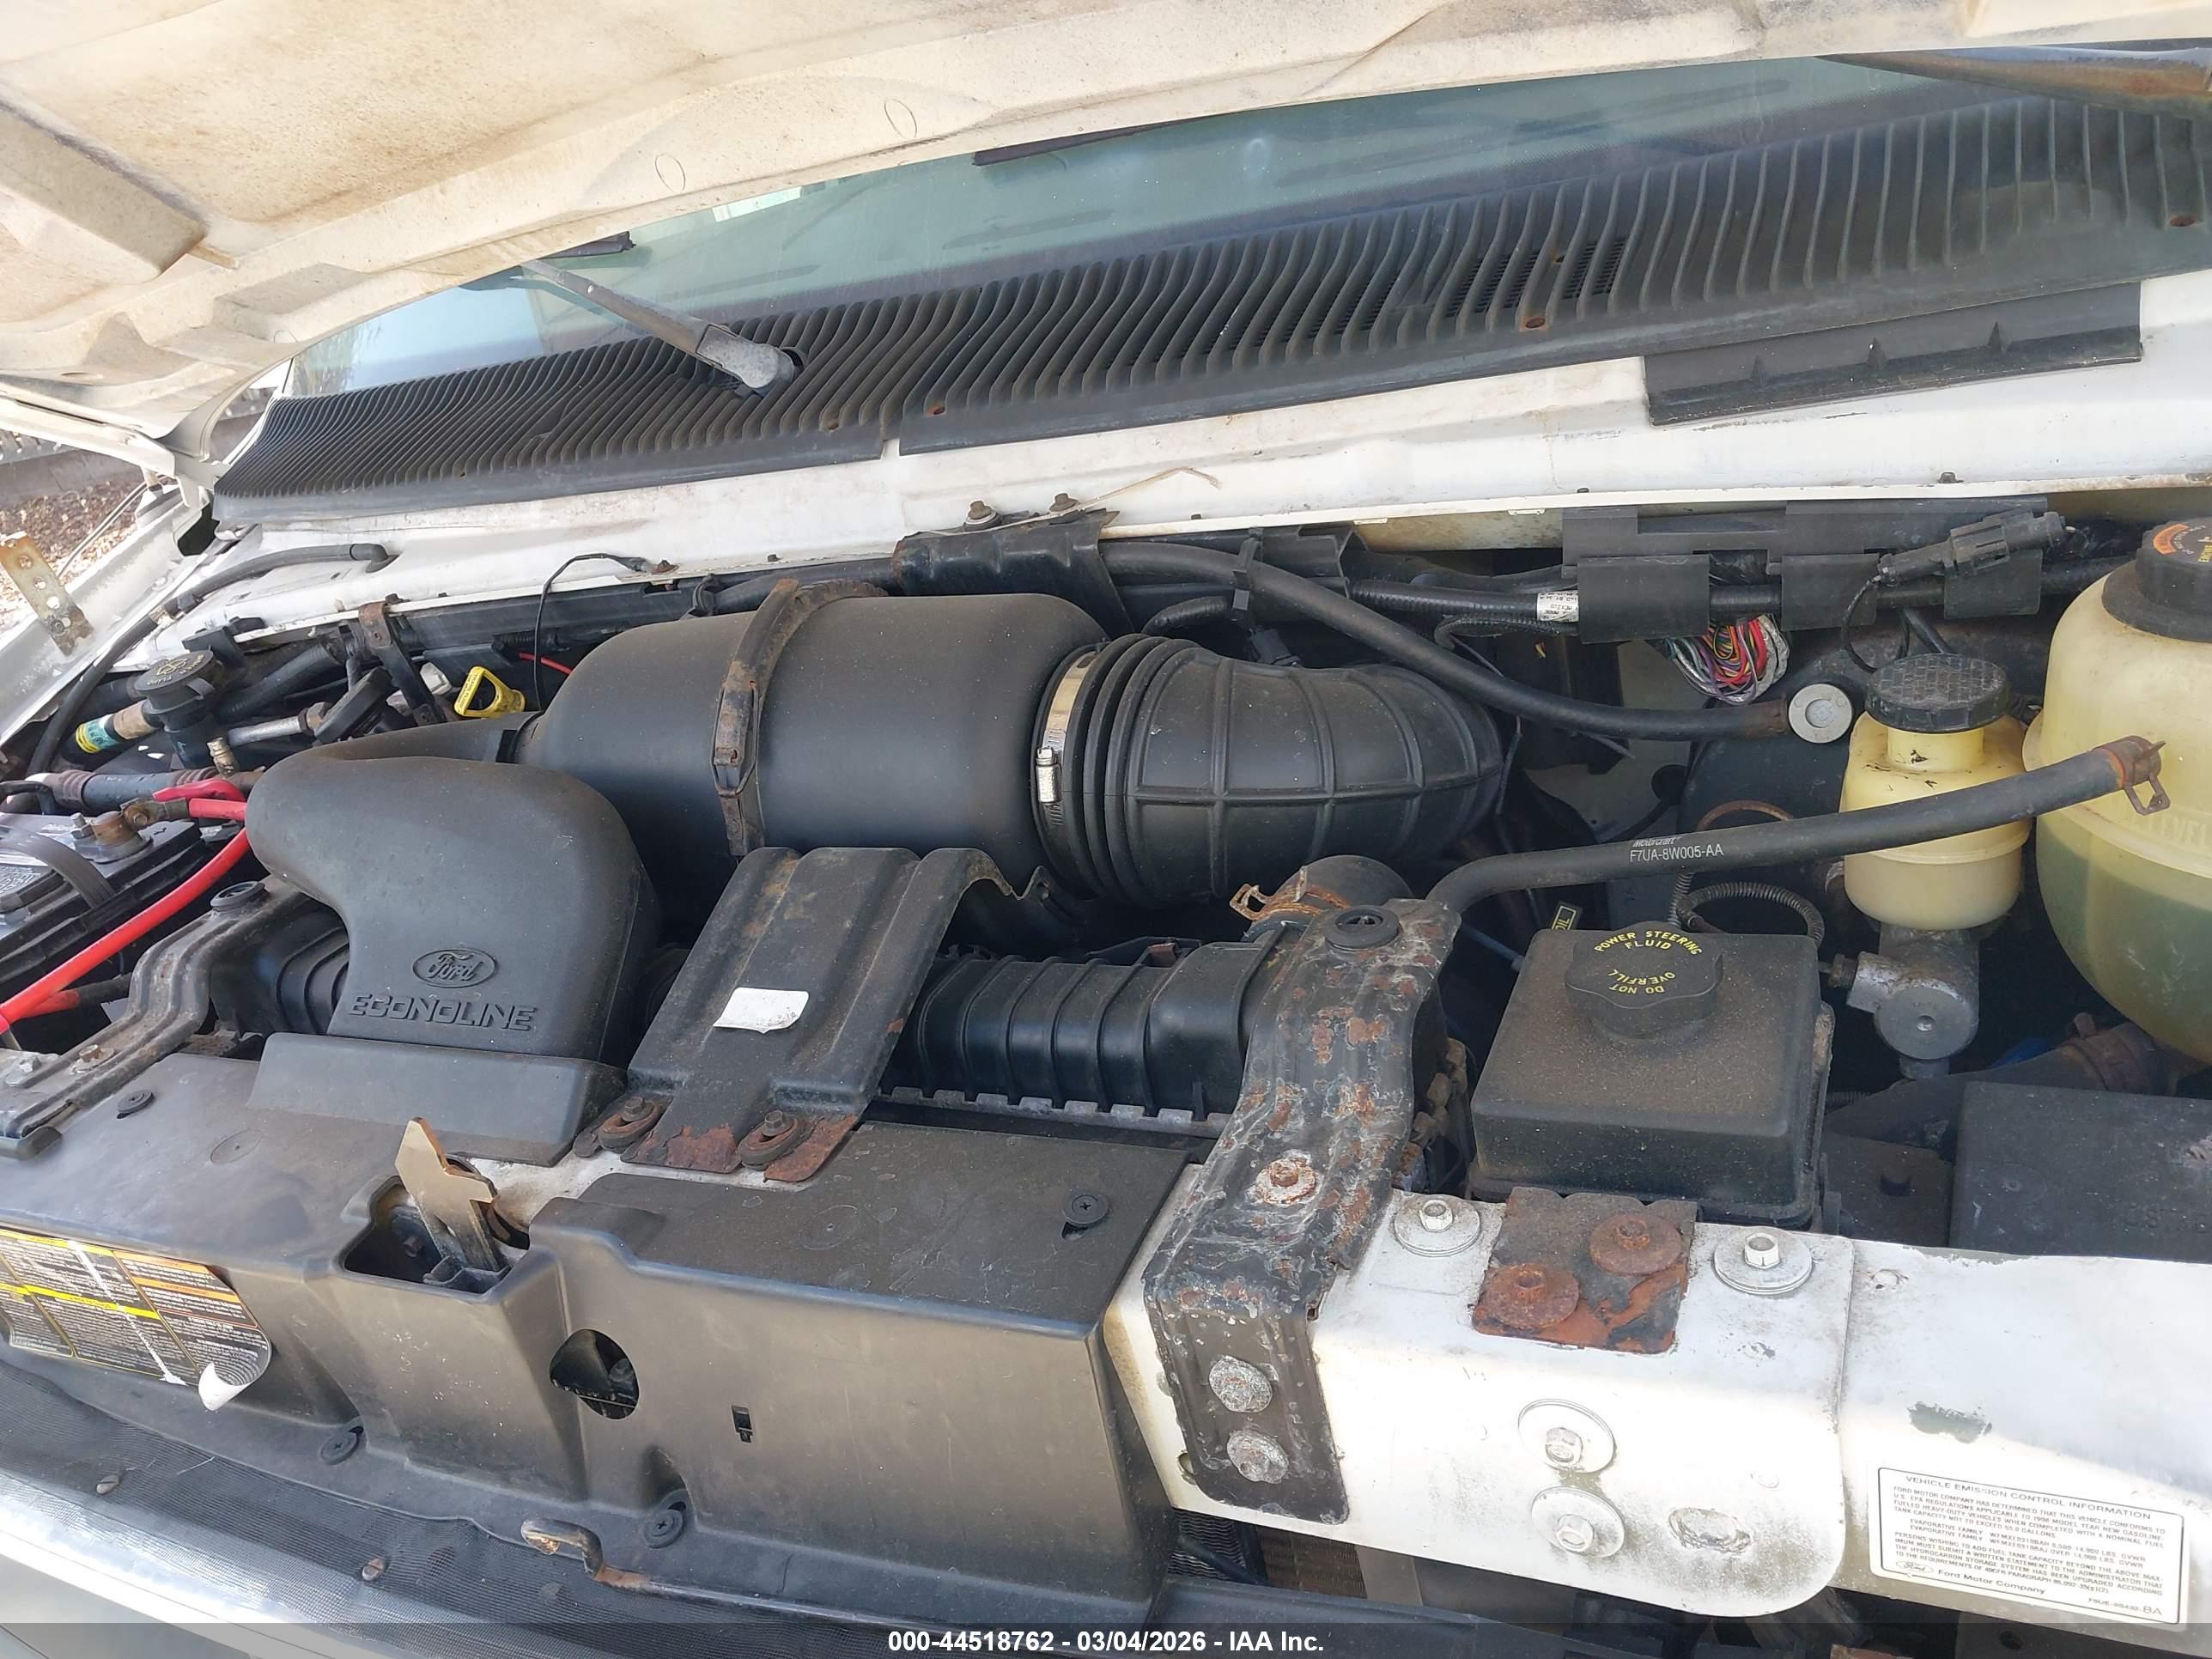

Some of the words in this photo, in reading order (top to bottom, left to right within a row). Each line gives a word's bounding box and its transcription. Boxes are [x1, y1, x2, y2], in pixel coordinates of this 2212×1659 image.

[1630, 843, 1724, 863] F7UA-8W005-AA
[1594, 933, 1637, 953] POWER
[1645, 931, 1703, 955] STEERING
[1624, 939, 1672, 951] FLUID
[428, 951, 483, 982] Ford
[1608, 969, 1676, 986] OVERFILL
[1608, 984, 1638, 994] NOT
[1645, 985, 1666, 994] DO
[349, 993, 538, 1032] ECONOLINE
[1905, 1476, 1950, 1488] VEHICLE
[1954, 1483, 2006, 1497] EMISSION
[2010, 1492, 2063, 1506] CONTROL
[2069, 1501, 2150, 1519] INFORMATION
[1914, 1489, 1938, 1498] MOTOR
[1941, 1493, 1973, 1504] COMPANY
[1991, 1501, 2037, 1513] DETERMINED
[2078, 1515, 2106, 1524] VEHICLE
[2109, 1520, 2152, 1532] CONFORMS
[1893, 1499, 1919, 1509] FUELED
[1968, 1511, 2001, 1522] VEHICLES
[2028, 1522, 2073, 1533] COMPLETED
[2106, 1534, 2140, 1544] NOMINAL
[1913, 1510, 1945, 1519] CAPACITY
[1976, 1520, 2002, 1528] EXCEED
[1926, 1498, 1972, 1510] REGULATIONS
[1976, 1506, 2017, 1517] APPLICABLE
[2052, 1518, 2077, 1527] MODEL
[1894, 1531, 1926, 1541] PERSONS
[1929, 1537, 1959, 1547] WISHING
[2008, 1550, 2026, 1559] TANK
[2028, 1553, 2063, 1565] CAPACITY
[2066, 1560, 2095, 1570] BEYOND
[2115, 1568, 2139, 1577] ABOVE
[1917, 1541, 1935, 1550] MUST
[1938, 1546, 1964, 1554] SUBMIT
[1973, 1551, 2004, 1561] WRITTEN
[2007, 1557, 2047, 1569] STATEMENT
[2078, 1569, 2141, 1584] ADMINISTRATOR
[2144, 1580, 2162, 1589] THAT
[1911, 1547, 1962, 1560] HYDROCARBON
[1965, 1556, 1996, 1566] STORAGE
[2001, 1562, 2029, 1572] SYSTEM
[2051, 1571, 2069, 1579] BEEN
[2072, 1575, 2112, 1587] UPGRADED
[2117, 1583, 2162, 1595] ACCORDING
[1919, 1555, 1971, 1569] REQUIREMENTS
[2008, 1570, 2051, 1583] PARAGRAPH
[1938, 1569, 1960, 1578] Ford
[1963, 1574, 1992, 1583] Motor
[1996, 1579, 2045, 1595] Company
